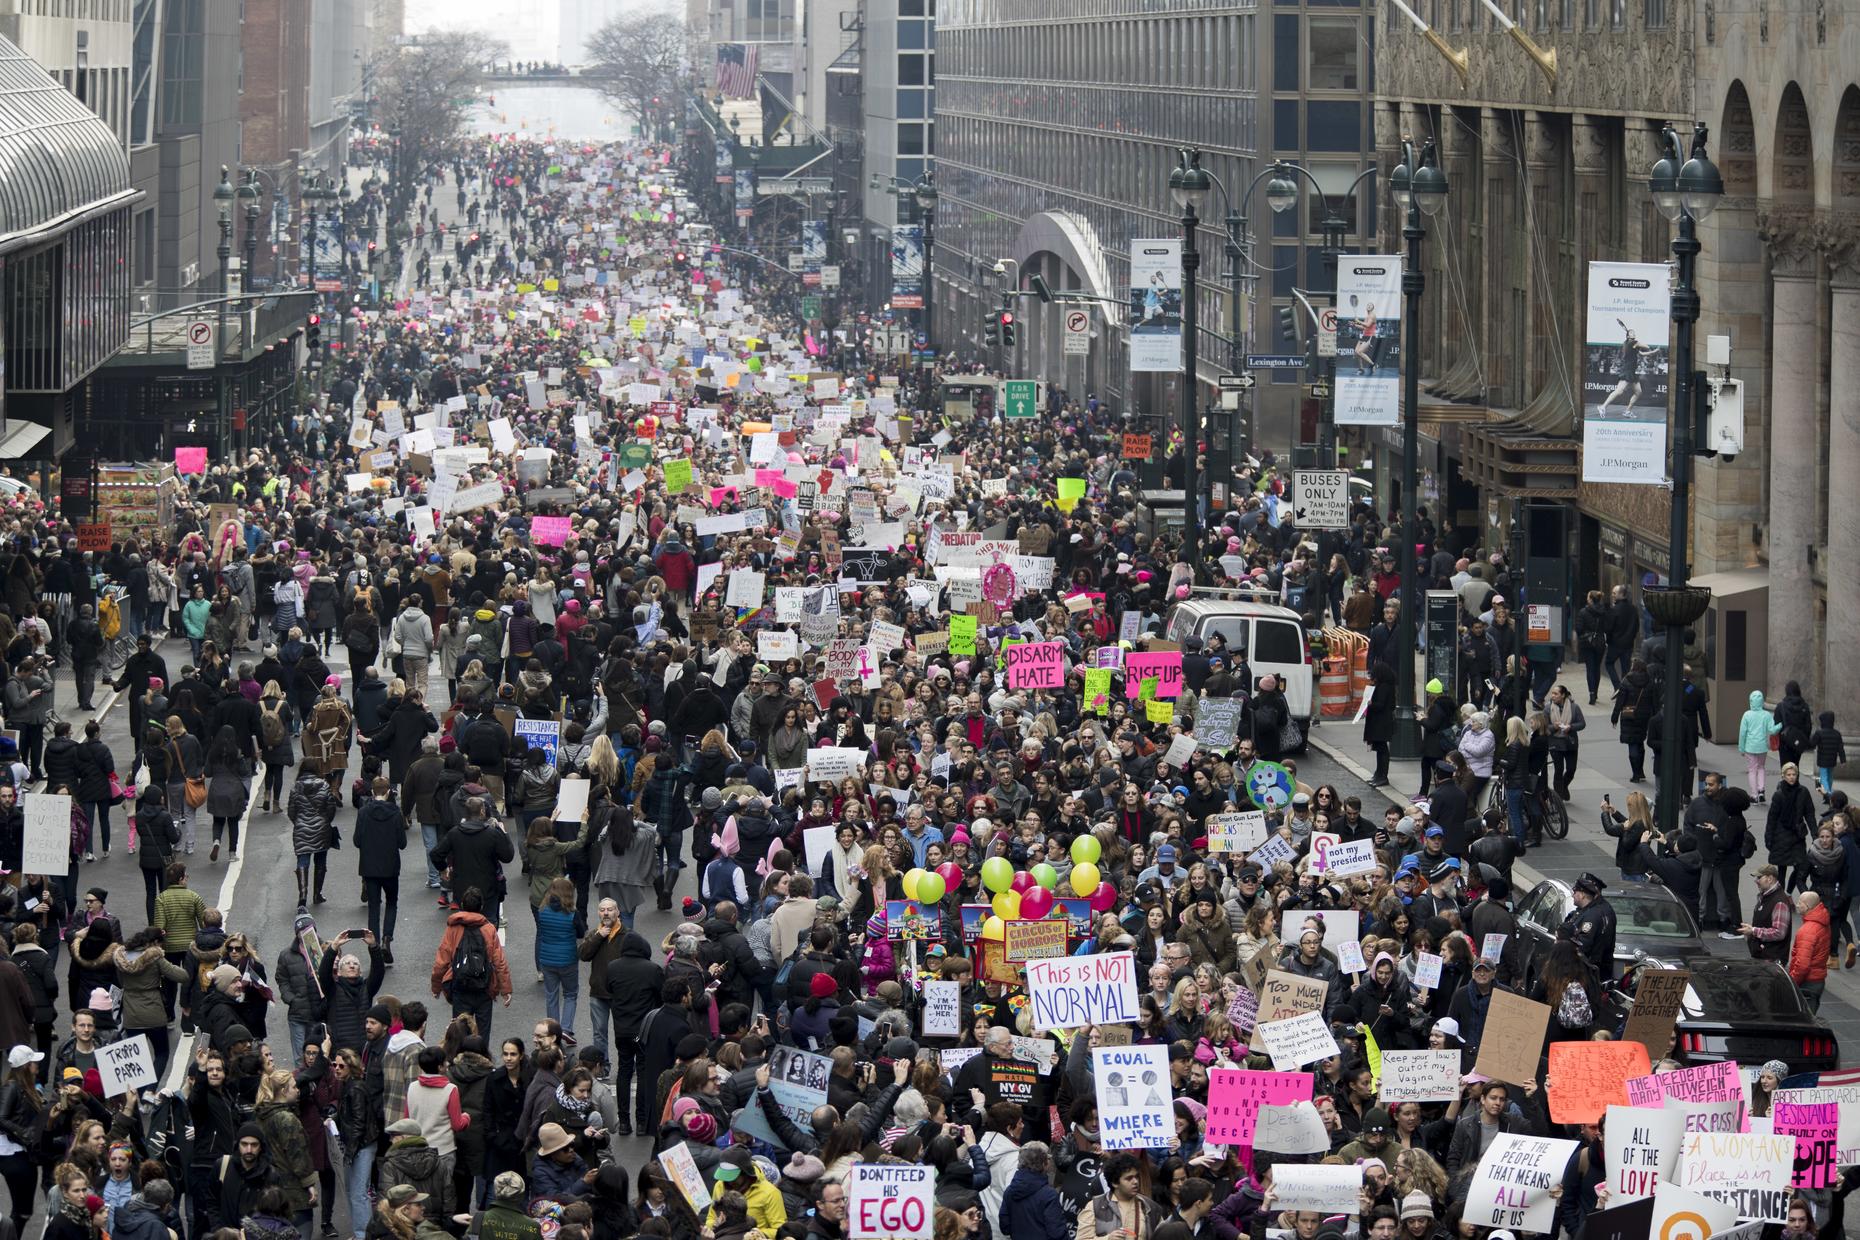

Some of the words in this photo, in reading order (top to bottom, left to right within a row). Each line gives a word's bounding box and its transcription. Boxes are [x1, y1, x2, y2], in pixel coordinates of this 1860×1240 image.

[1623, 298, 1646, 306] Morgan
[1249, 358, 1287, 367] Lexington
[1288, 358, 1303, 366] Ave
[1613, 429, 1653, 437] Anniversary
[1125, 437, 1149, 445] RAISE
[1125, 446, 1149, 454] PLOW
[1600, 458, 1648, 470] J.P.Morgan
[1300, 474, 1341, 485] BUSES
[1305, 488, 1337, 499] ONLY
[80, 527, 108, 537] RAISE
[80, 537, 109, 547] PLOW
[781, 590, 798, 599] WE
[833, 641, 847, 649] MY
[919, 642, 945, 651] DARKNESS
[829, 650, 858, 663] BODY
[1009, 644, 1063, 665] DISARM
[1016, 666, 1056, 686] HATE
[518, 720, 559, 732] RESISTANCE
[1217, 815, 1233, 823] Smart
[1328, 847, 1344, 857] not
[1346, 845, 1360, 855] my
[1330, 853, 1372, 869] president
[1010, 924, 1052, 939] CIRCUS
[1011, 933, 1065, 949] HORRORS
[1095, 955, 1131, 983] NOT
[1644, 976, 1664, 989] THE
[1665, 976, 1688, 990] LEFT
[1297, 986, 1323, 1003] MUCH
[1640, 990, 1684, 1005] STANDS
[1034, 983, 1137, 1025] NORMAL
[1632, 1004, 1681, 1018] TOGETHER
[1265, 1035, 1285, 1044] there
[1288, 1031, 1307, 1042] would
[1307, 1030, 1316, 1038] be
[1316, 1028, 1331, 1036] more
[1268, 1024, 1282, 1034] men
[1102, 1053, 1153, 1066] EQUAL
[1383, 1052, 1408, 1064] Keep
[1411, 1054, 1430, 1064] your
[1435, 1051, 1457, 1060] laws
[992, 1061, 1035, 1075] DISARM
[1432, 1063, 1446, 1073] my
[1218, 1075, 1302, 1088] EQUALITY
[1398, 1074, 1433, 1085] Vagina
[1627, 1076, 1651, 1092] THE
[1655, 1068, 1694, 1088] NEEDS
[1696, 1067, 1708, 1080] OF
[1710, 1062, 1731, 1076] THE
[1251, 1089, 1267, 1099] IS
[1630, 1089, 1661, 1106] MANY
[1665, 1077, 1725, 1098] OUTWEIGH
[1772, 1089, 1804, 1104] ABORT
[1775, 1102, 1838, 1125] RESISTANCE
[1104, 1114, 1163, 1130] WHERE
[1711, 1111, 1737, 1132] PUSSY
[1132, 1130, 1144, 1139] IT
[1631, 1127, 1650, 1145] ALL
[1789, 1128, 1818, 1138] BUILT
[1821, 1127, 1836, 1138] ON
[1509, 1138, 1526, 1151] WE
[1532, 1141, 1551, 1154] THE
[1687, 1136, 1702, 1156] A
[1712, 1136, 1790, 1164] WOMAN'S
[1500, 1151, 1541, 1167] PEOPLE
[1623, 1147, 1635, 1164] OF
[1641, 1149, 1659, 1166] THE
[895, 1168, 925, 1182] FEED
[1488, 1164, 1516, 1182] THAT
[1516, 1170, 1551, 1190] MEANS
[1688, 1161, 1729, 1187] Place
[1735, 1167, 1749, 1181] is
[1751, 1166, 1772, 1184] in
[1620, 1168, 1659, 1196] LOVE
[883, 1185, 898, 1196] HIS
[1494, 1186, 1531, 1209] ALL
[860, 1196, 925, 1233] EGO
[1491, 1208, 1505, 1225] OF
[1510, 1210, 1525, 1226] US
